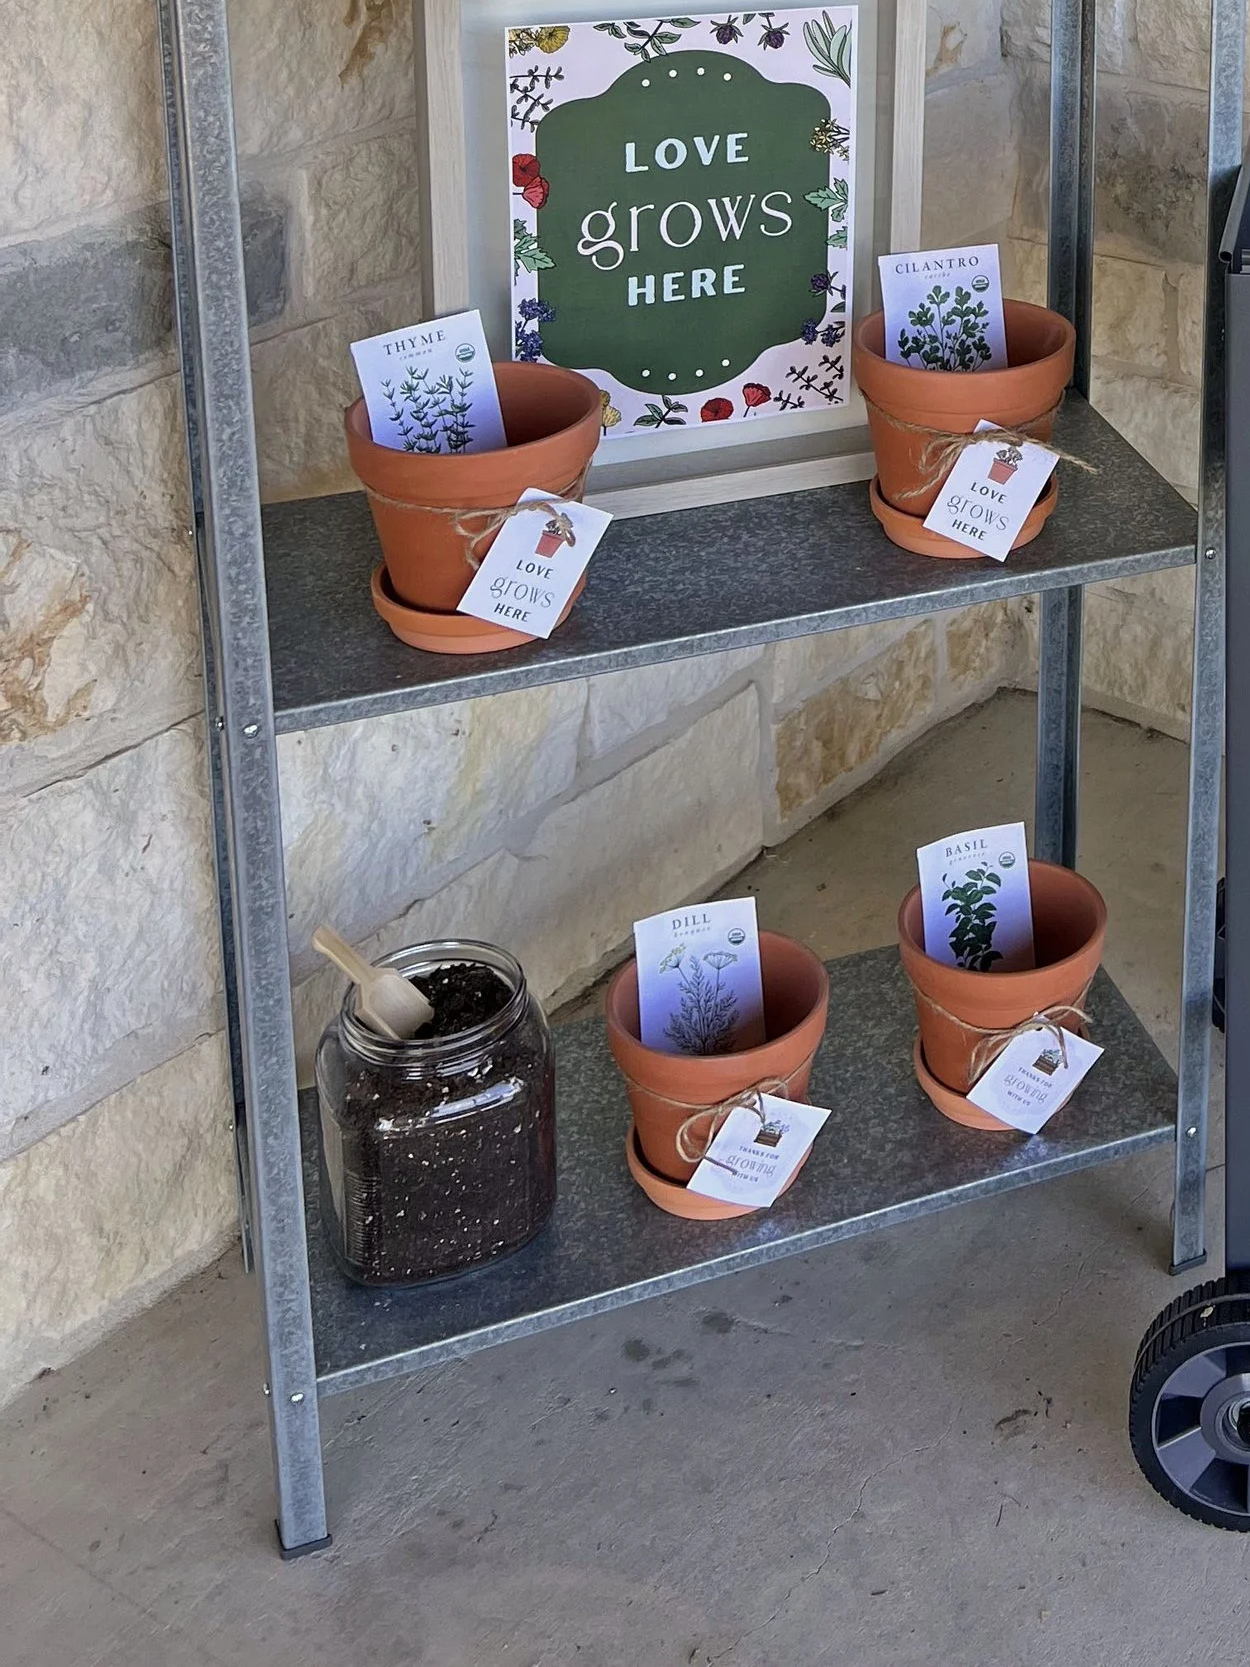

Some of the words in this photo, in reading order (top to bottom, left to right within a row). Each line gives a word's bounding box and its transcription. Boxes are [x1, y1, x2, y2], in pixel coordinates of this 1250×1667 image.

[624, 131, 750, 174] LOVE
[576, 190, 794, 272] grows
[895, 255, 980, 275] CILANTRO
[627, 263, 746, 307] HERE
[383, 329, 447, 356] THYME
[970, 481, 1008, 504] LOVE
[946, 494, 1010, 531] grows
[951, 518, 988, 541] HERE
[515, 558, 555, 580] LOVE
[489, 576, 556, 608] grows
[493, 602, 532, 623] HERE
[945, 838, 989, 858] BASIL
[672, 913, 712, 931] DILL
[1003, 1074, 1049, 1104] growing
[725, 1154, 779, 1179] growing
